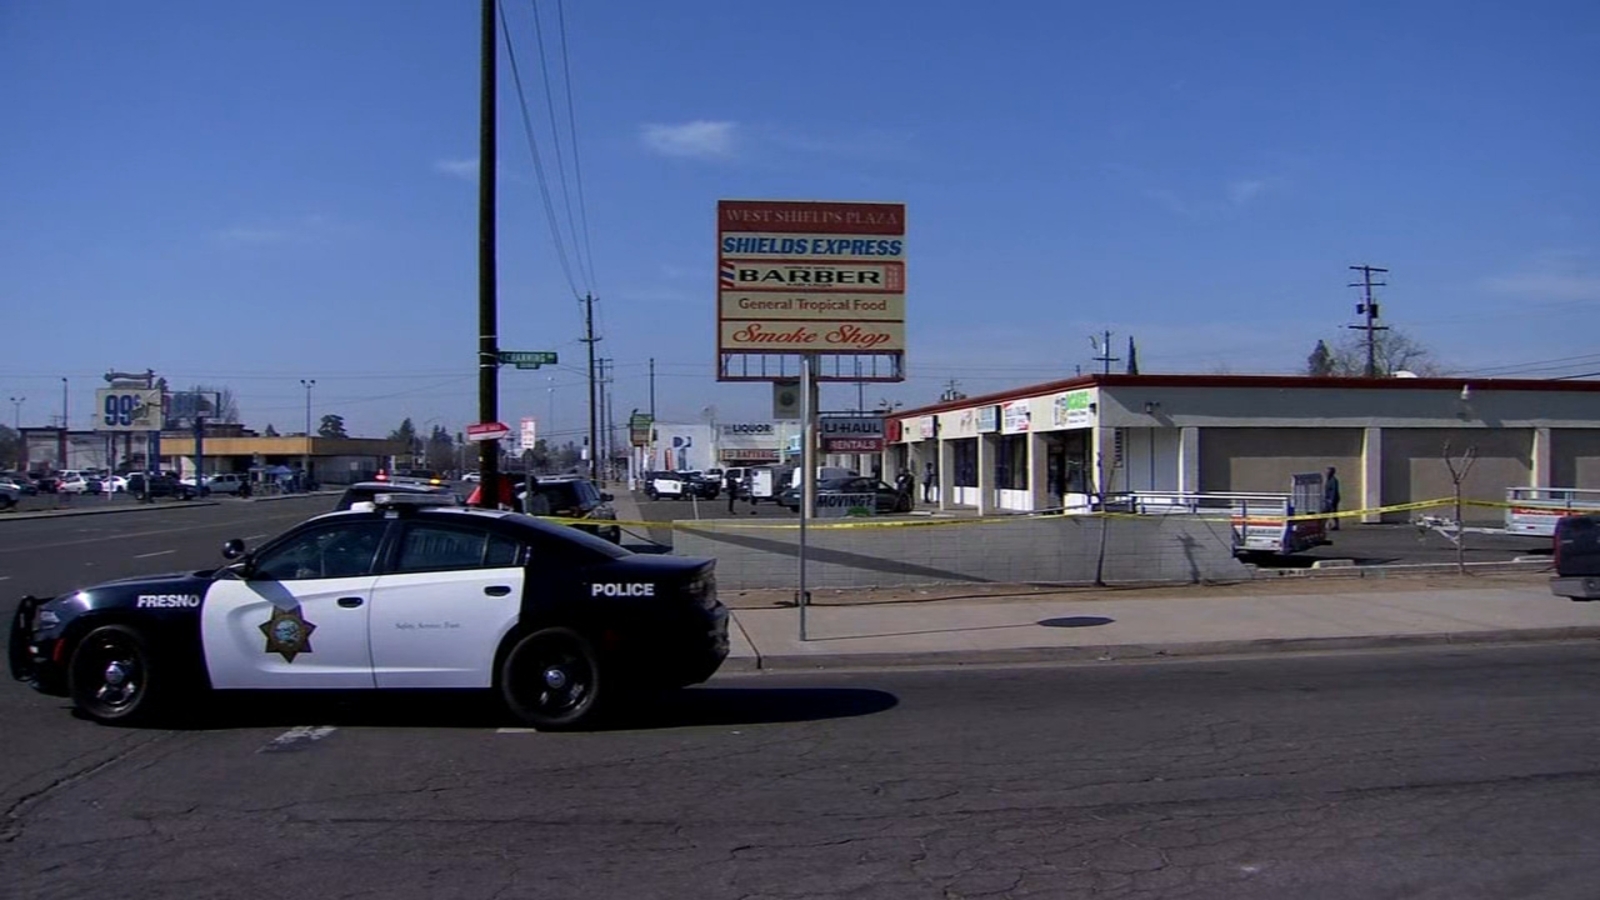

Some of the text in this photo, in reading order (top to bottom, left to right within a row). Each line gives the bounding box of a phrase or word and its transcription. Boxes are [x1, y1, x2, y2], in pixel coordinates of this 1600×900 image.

[726, 209, 772, 222] WEST
[723, 237, 902, 256] SHIELDS EXPRESS
[739, 269, 881, 285] BARBER
[739, 298, 887, 313] General Tropical Food
[732, 323, 891, 348] Smoke Shop
[733, 424, 774, 434] LIQUOR
[830, 440, 876, 449] RENTALS
[591, 583, 655, 597] POLICE
[137, 594, 200, 608] FRESNO
